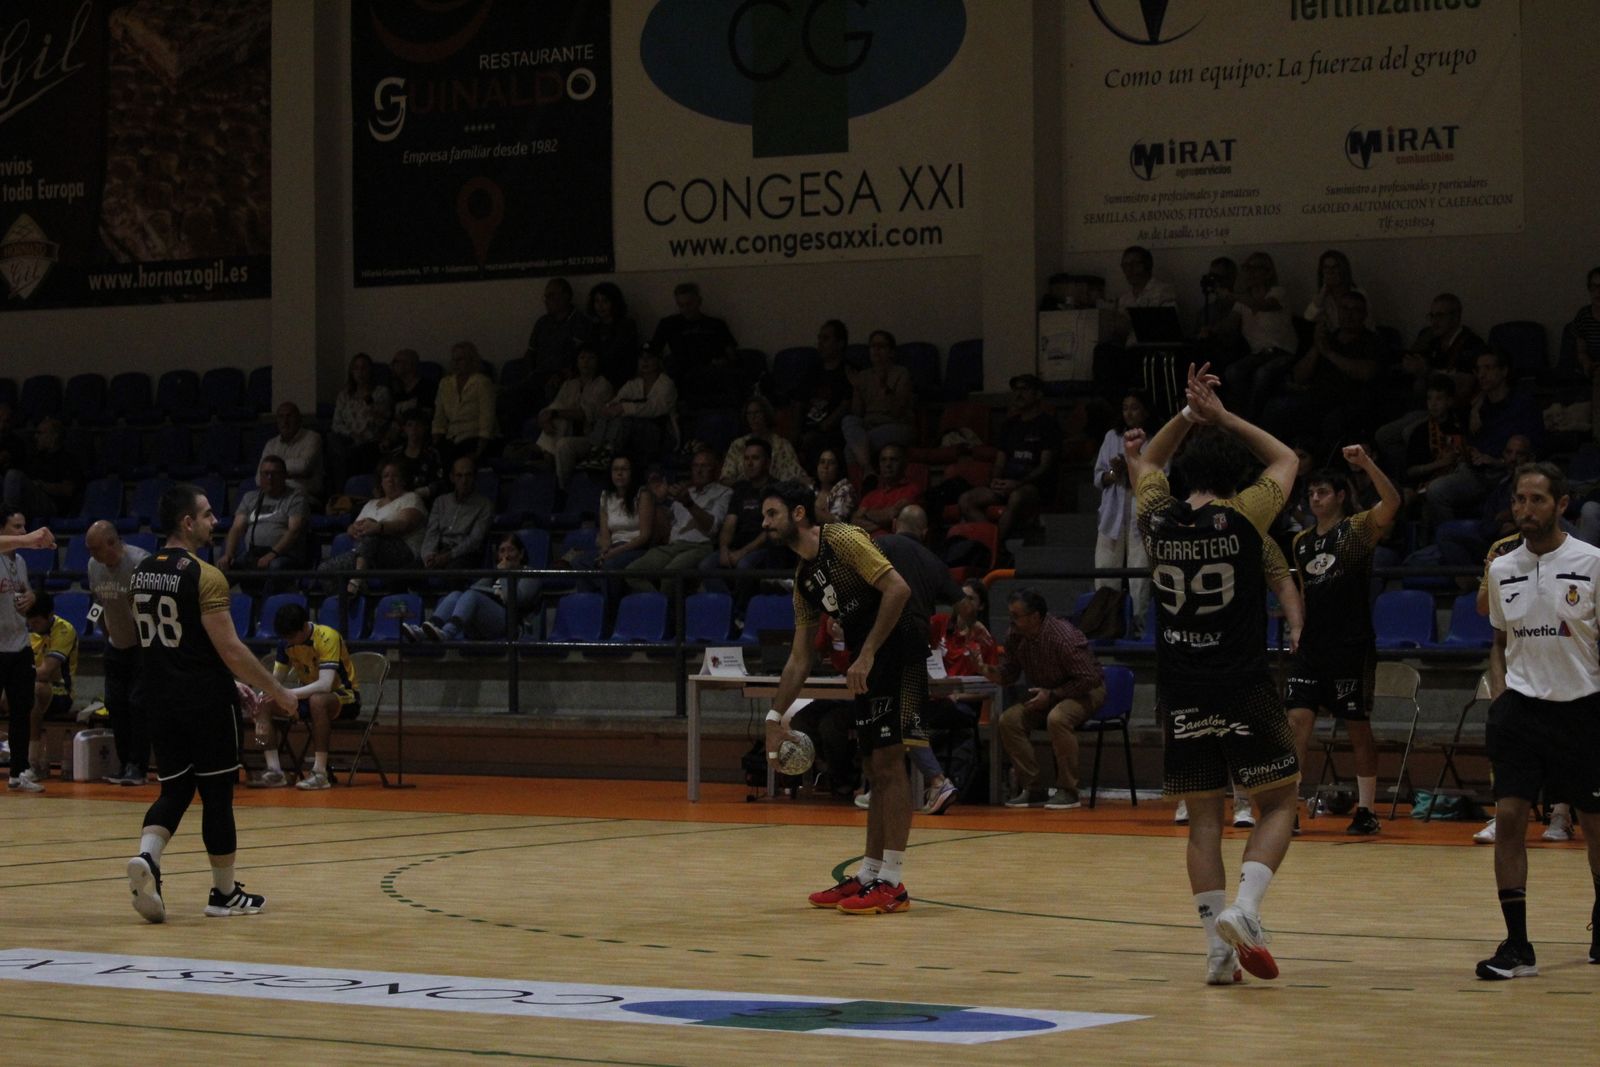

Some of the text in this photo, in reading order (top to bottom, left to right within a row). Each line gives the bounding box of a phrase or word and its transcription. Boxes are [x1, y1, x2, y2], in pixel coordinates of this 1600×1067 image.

[479, 43, 595, 70] RESTAURANTE
[1104, 45, 1478, 90] Como un equipo: La fuerza del grupo
[402, 138, 560, 167] Empresa familiar desde 1982
[3, 177, 85, 205] toda Europa
[643, 162, 965, 226] CONGESA XXI
[669, 223, 943, 257] www.congesaxxi.com
[88, 258, 249, 290] www.hornazogil.es
[1156, 534, 1240, 560] CARRETERO
[813, 569, 827, 587] 10
[1152, 562, 1235, 616] 99
[132, 593, 183, 648] 68
[1512, 624, 1558, 639] helvetia
[1239, 755, 1297, 782] GUINALDO
